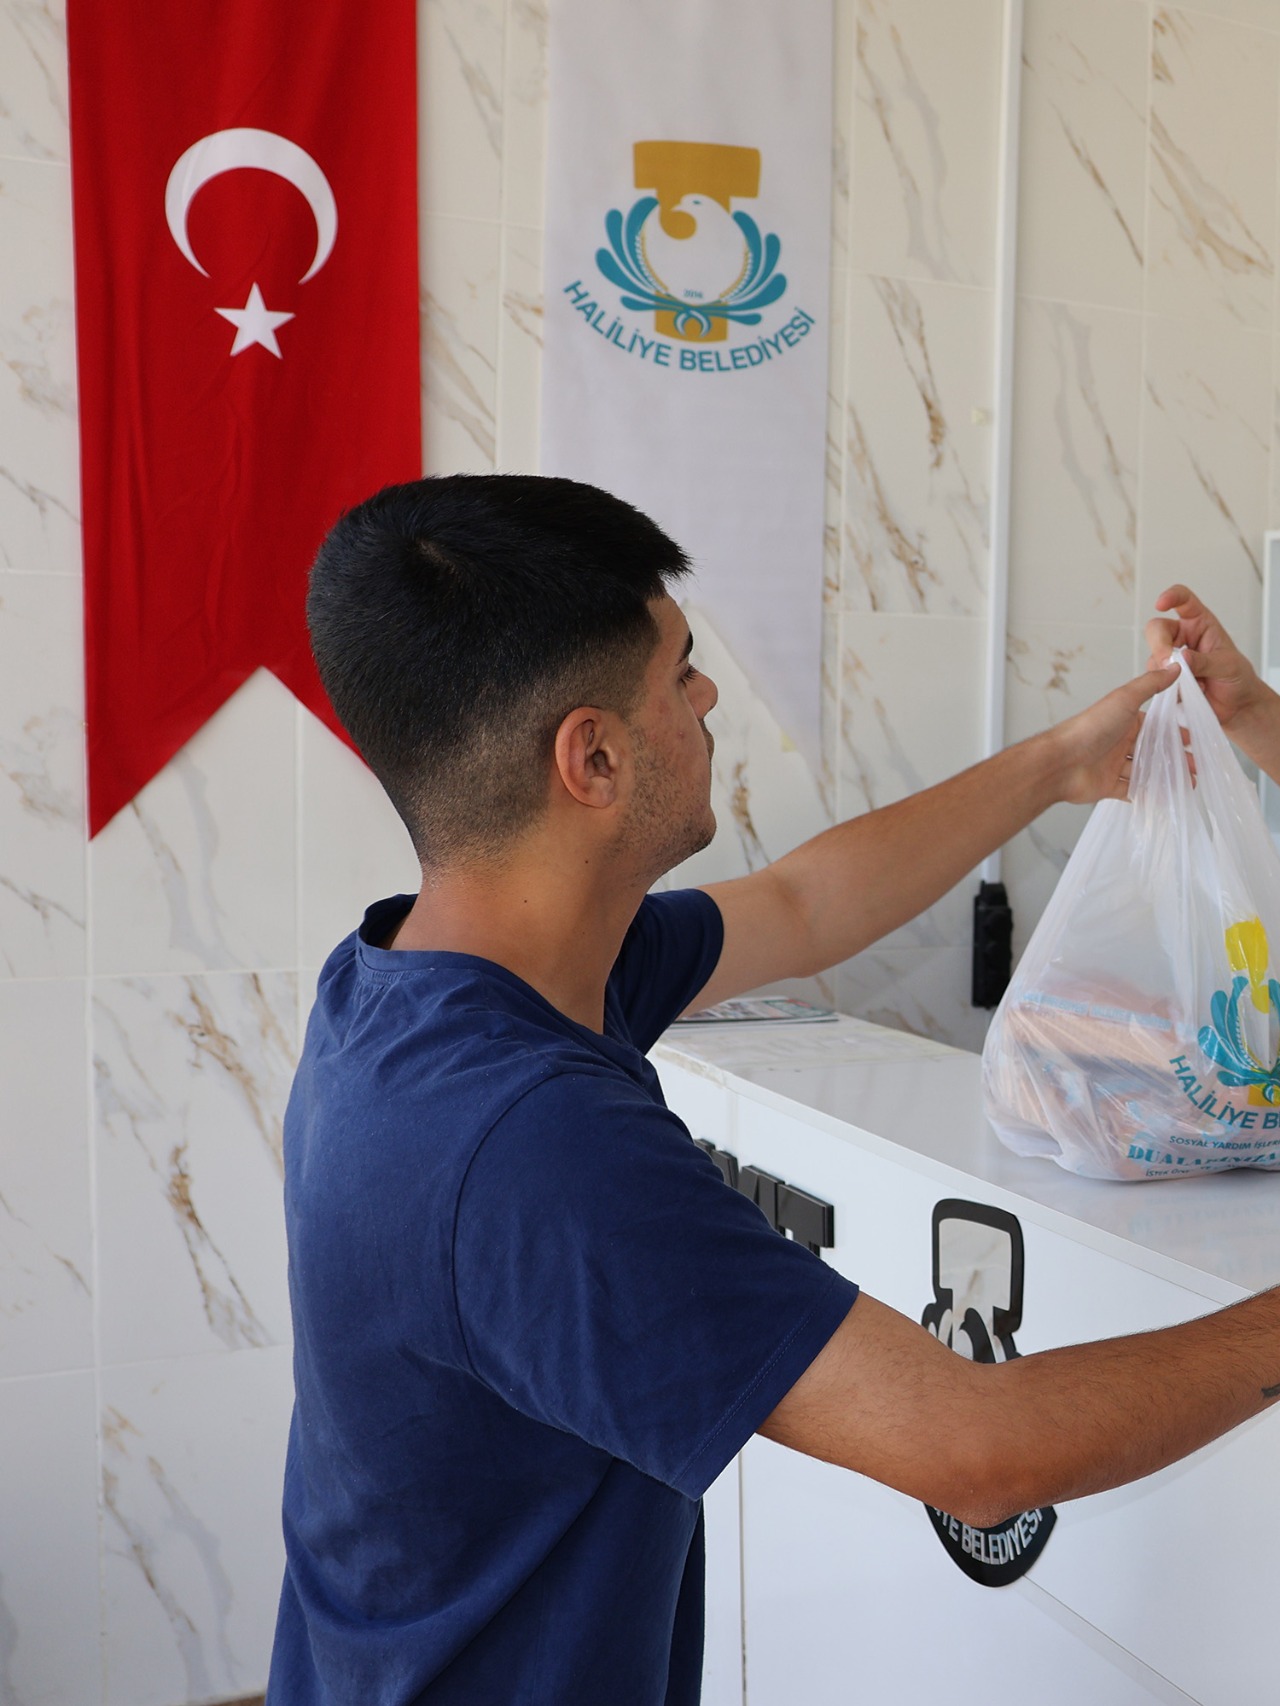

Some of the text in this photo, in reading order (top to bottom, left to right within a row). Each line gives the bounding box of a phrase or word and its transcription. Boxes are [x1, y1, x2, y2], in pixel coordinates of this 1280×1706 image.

[563, 280, 816, 373] HALİLİYE BELEDİYESİ
[1169, 1054, 1258, 1130] HALİLİYE
[1169, 1135, 1208, 1148] SOSYAL
[1212, 1141, 1251, 1150] YARDIM
